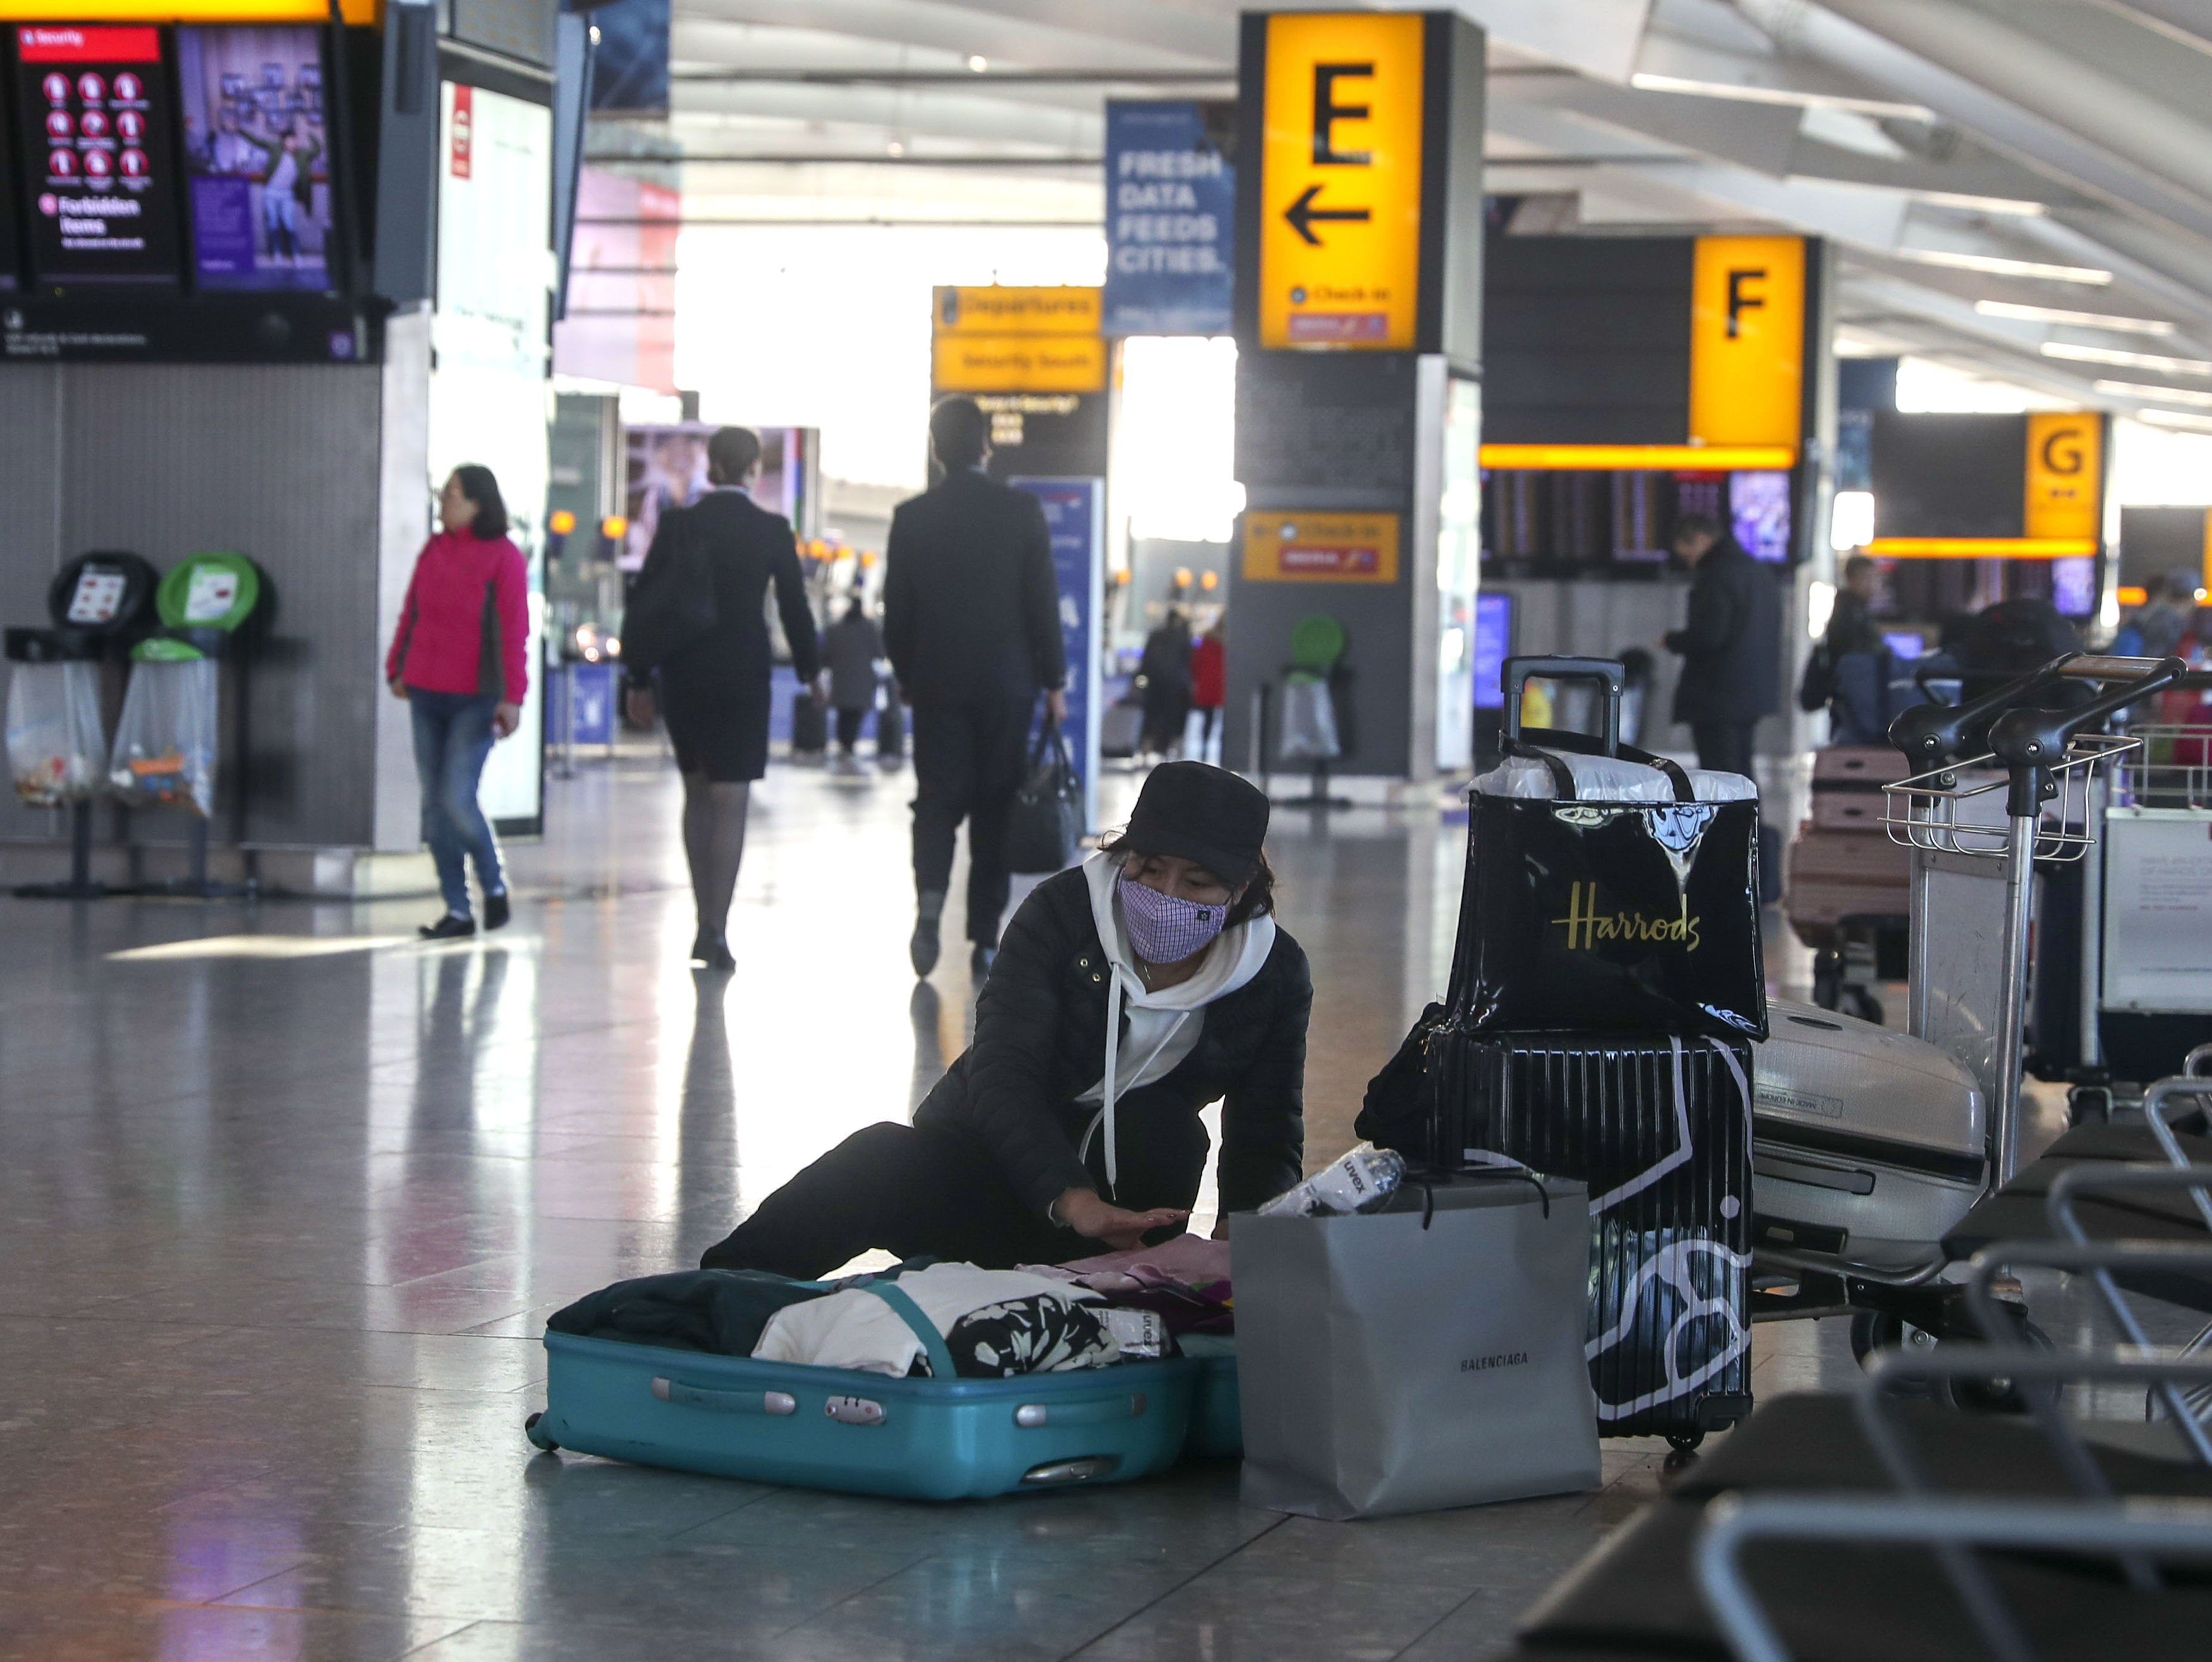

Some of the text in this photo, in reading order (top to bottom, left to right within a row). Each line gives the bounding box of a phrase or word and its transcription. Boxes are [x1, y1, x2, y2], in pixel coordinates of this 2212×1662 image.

[1312, 63, 1374, 165] E
[1118, 150, 1222, 179] FRESH
[1117, 182, 1198, 210] DATA
[1117, 214, 1218, 242] FEEDS
[1727, 270, 1766, 339] F
[2042, 428, 2083, 475] G
[1551, 881, 1700, 952] Harrods
[1344, 1160, 1366, 1194] uvex
[1461, 1352, 1528, 1373] BALENCIAGA
